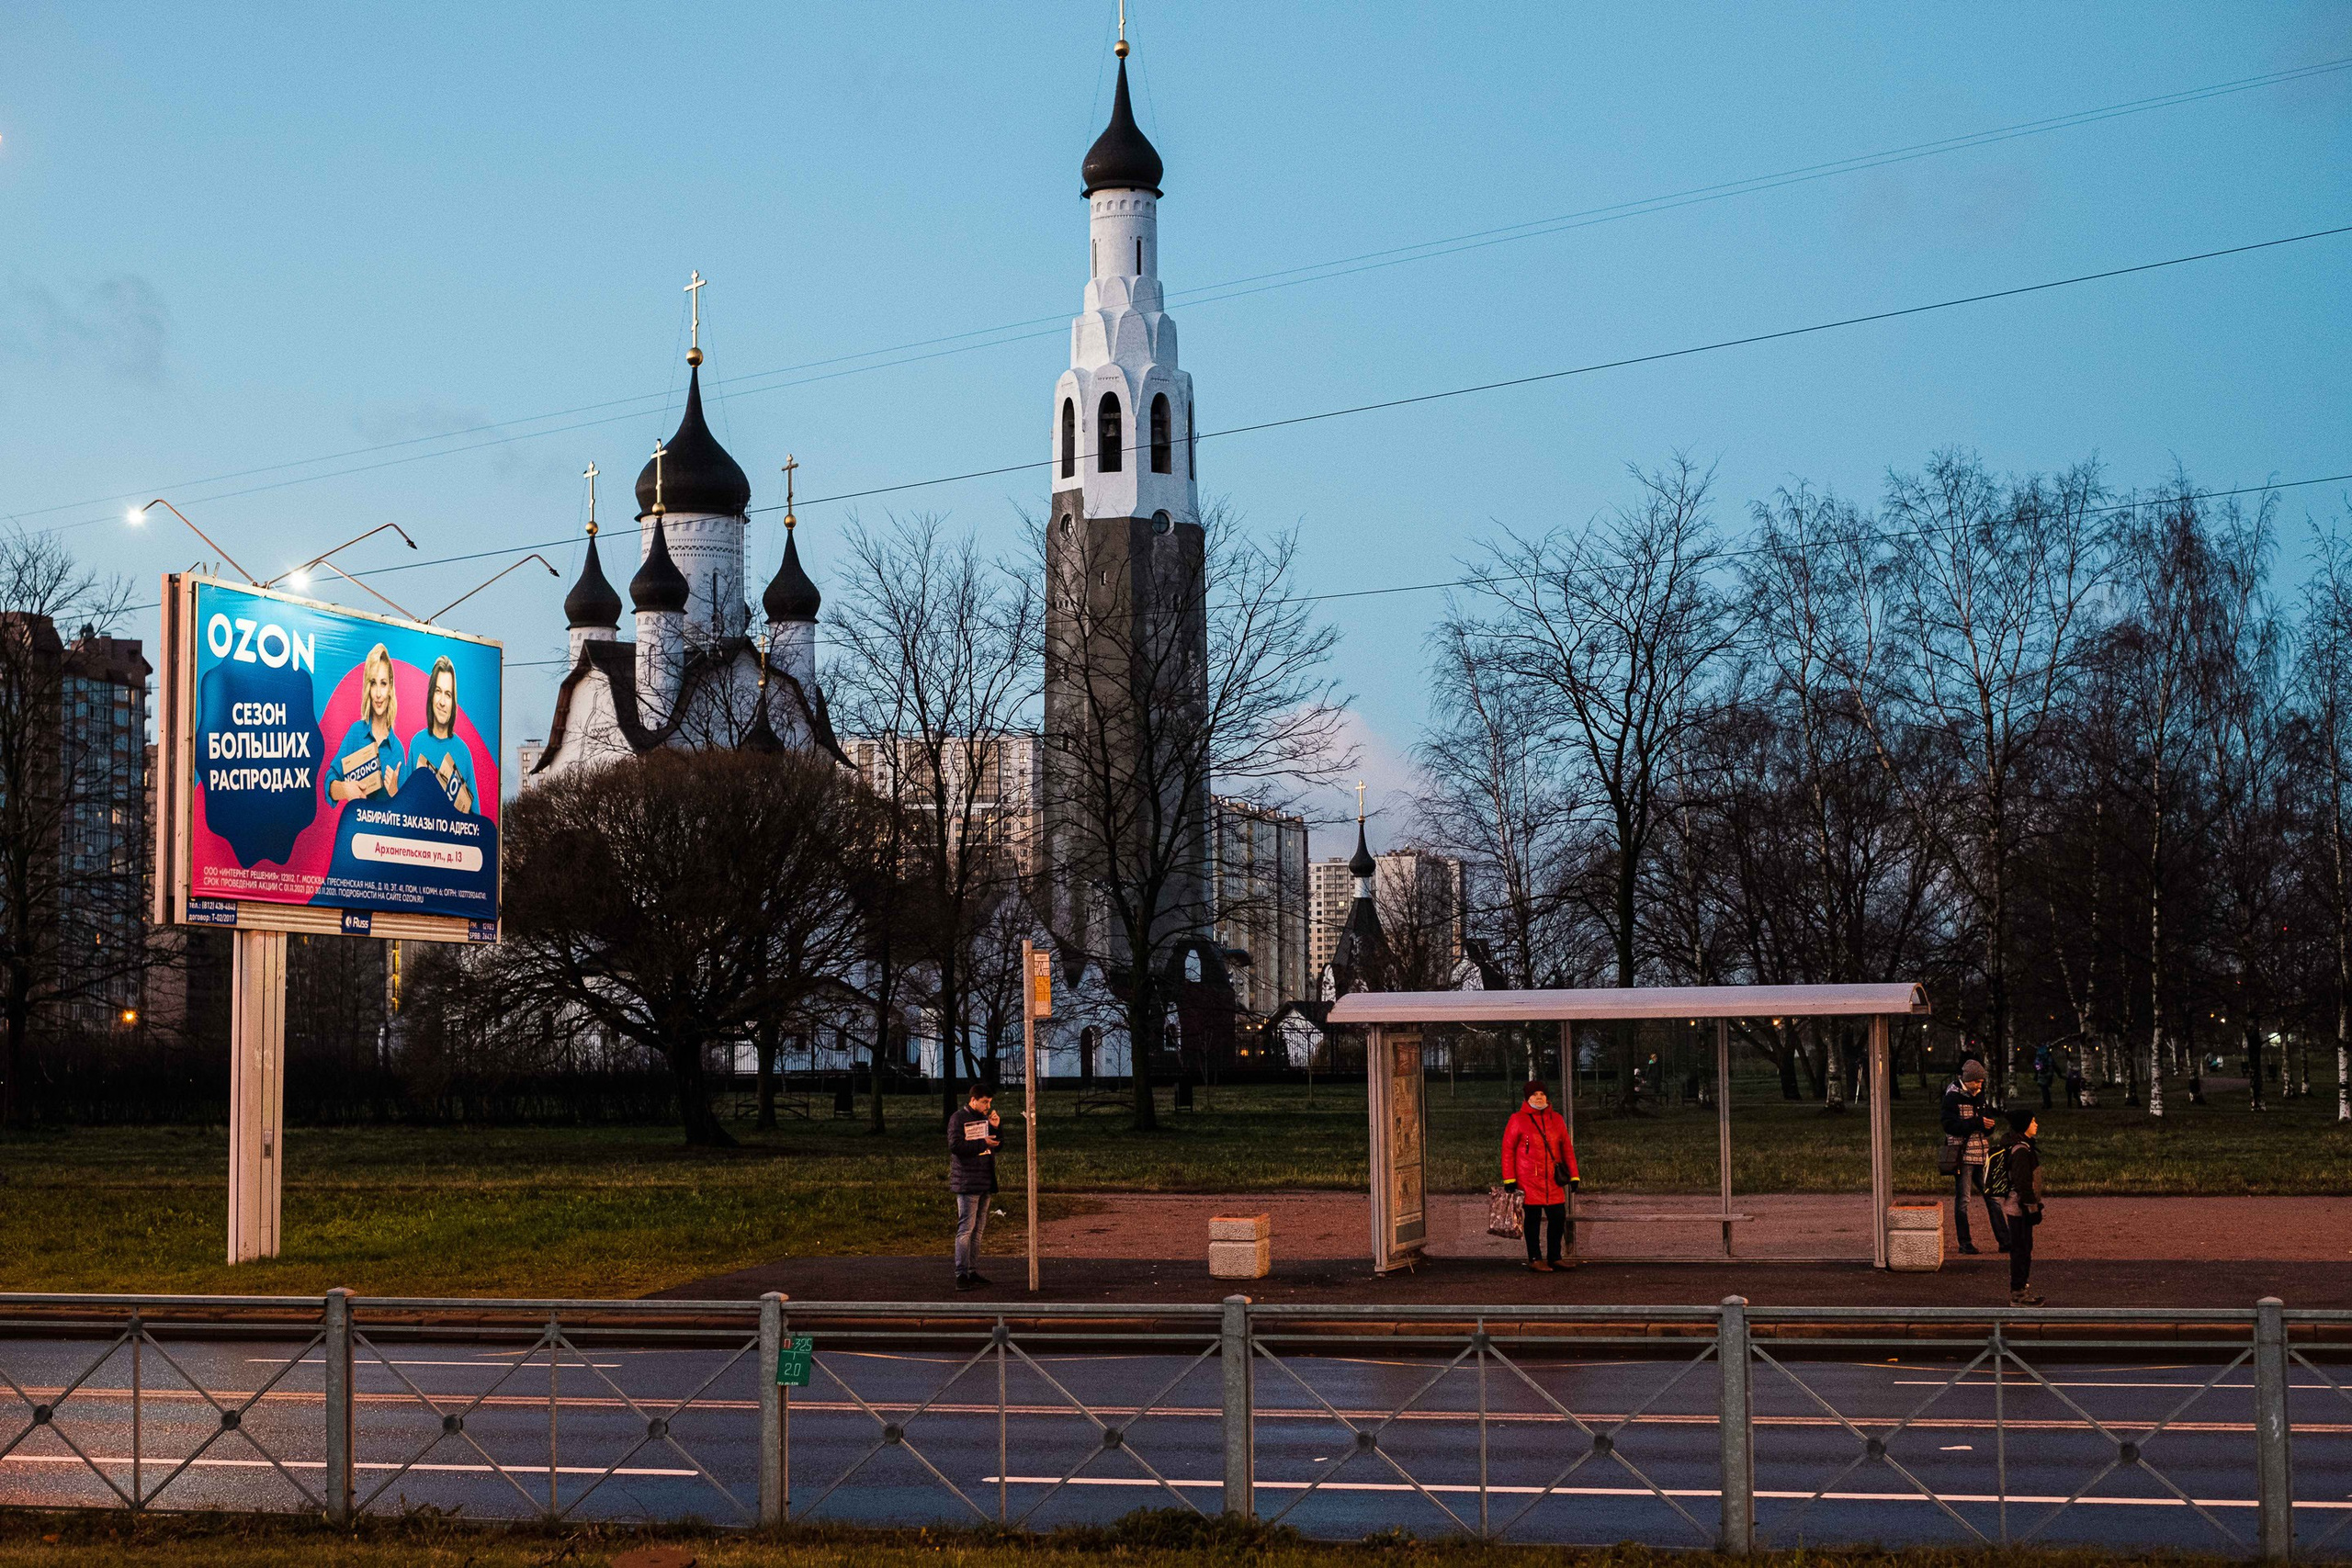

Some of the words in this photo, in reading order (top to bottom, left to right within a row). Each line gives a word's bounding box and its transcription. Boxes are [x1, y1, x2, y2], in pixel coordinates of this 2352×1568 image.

[208, 613, 315, 674] OZON
[232, 702, 287, 726] СЕЗОН
[208, 731, 311, 760] БОЛЬШИХ
[209, 767, 311, 793] РАСПРОДАЖ
[356, 808, 401, 827] ЗАБИРАЙТЕ
[402, 814, 435, 831] ЗАКАЗЫ
[436, 818, 448, 832] ПО
[449, 820, 480, 837] АДРЕСУ:
[375, 841, 431, 860] Архангельская
[433, 850, 446, 863] ул.,
[447, 852, 454, 863] д.
[455, 851, 463, 863] 13
[203, 866, 219, 876] ООО
[220, 868, 250, 878] «ИНТЕРНЕТ
[301, 875, 326, 886] МОСКВА,
[326, 877, 364, 889] ПРЕСНЕНСКАЯ
[203, 876, 220, 886] СРОК
[220, 878, 257, 889] ПРОВЕДЕНИЯ
[258, 882, 278, 891] АКЦИИ
[305, 885, 314, 895] ДО
[338, 887, 377, 899] ПОДРОБНОСТИ
[377, 891, 385, 900] НА
[385, 892, 401, 901] САЙТЕ
[352, 916, 369, 929] Russ
